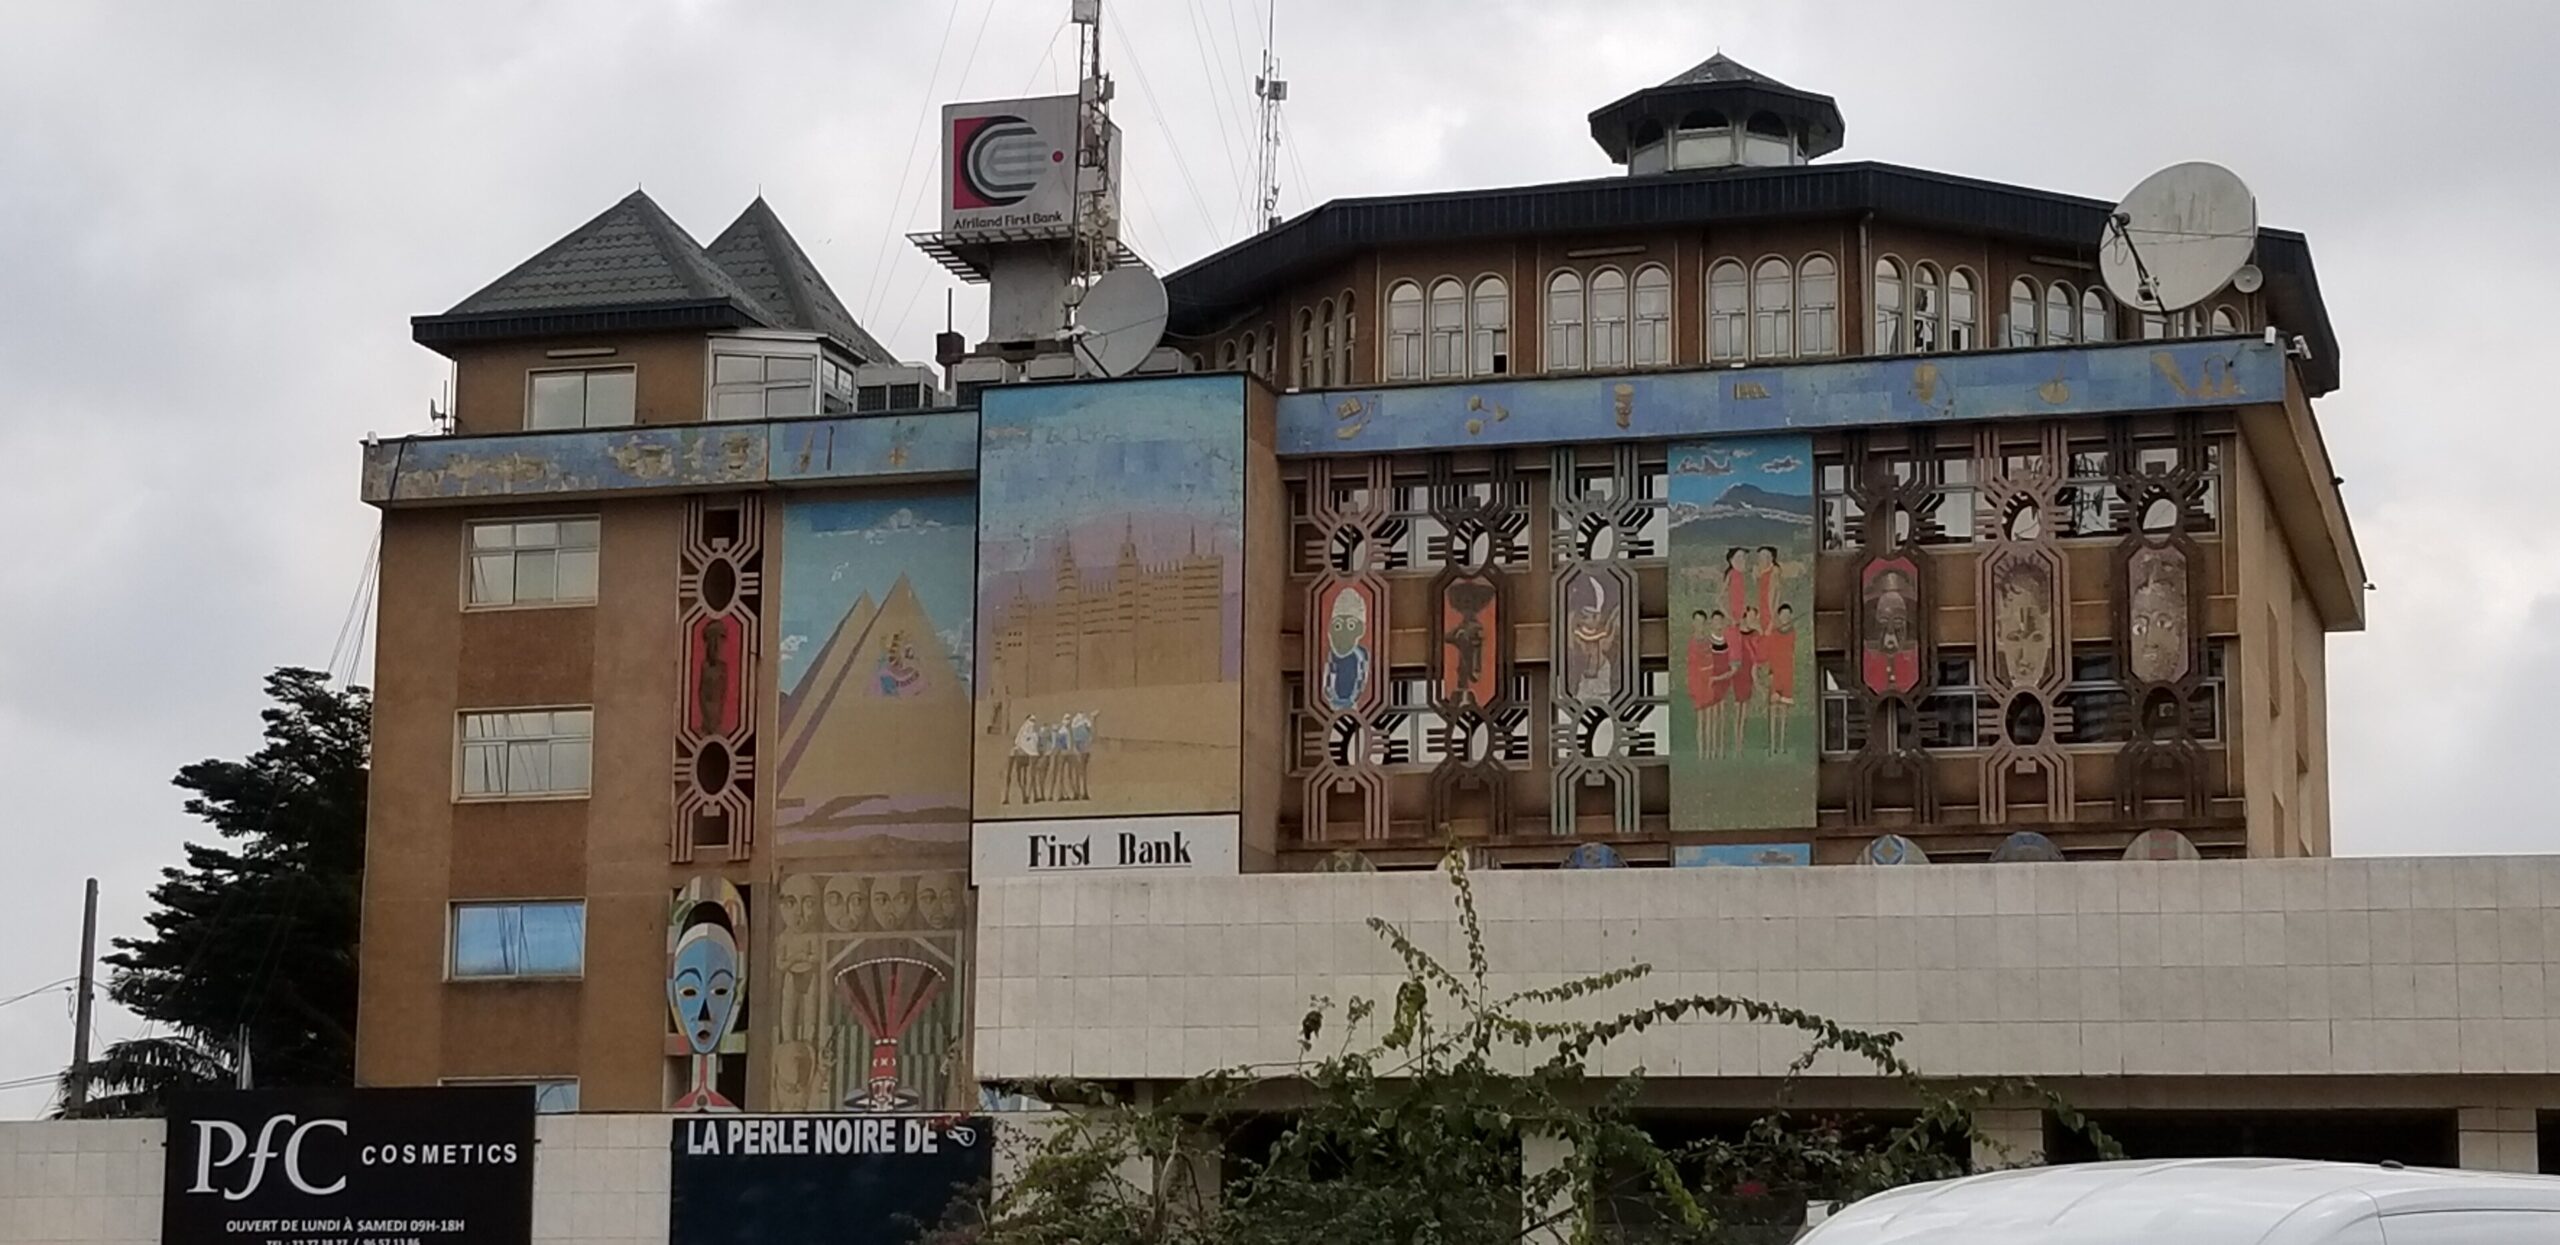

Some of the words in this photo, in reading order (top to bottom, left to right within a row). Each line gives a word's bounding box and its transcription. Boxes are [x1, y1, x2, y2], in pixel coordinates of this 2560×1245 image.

[953, 216, 1002, 230] Afriland
[1005, 212, 1030, 227] First
[1034, 211, 1063, 225] Bank
[1028, 835, 1091, 868] First
[1118, 831, 1192, 865] Bank
[687, 1120, 721, 1155] LA
[727, 1119, 809, 1155] PERLE
[814, 1118, 896, 1154] NOIRE
[904, 1118, 938, 1154] DE
[361, 1143, 518, 1166] COSMETICS
[225, 1219, 279, 1233] OUVERT
[280, 1219, 299, 1232] DE
[301, 1219, 341, 1232] LUNDI
[342, 1216, 354, 1232] À
[356, 1219, 408, 1233] SAMEDI
[409, 1219, 465, 1233] 09H-18H
